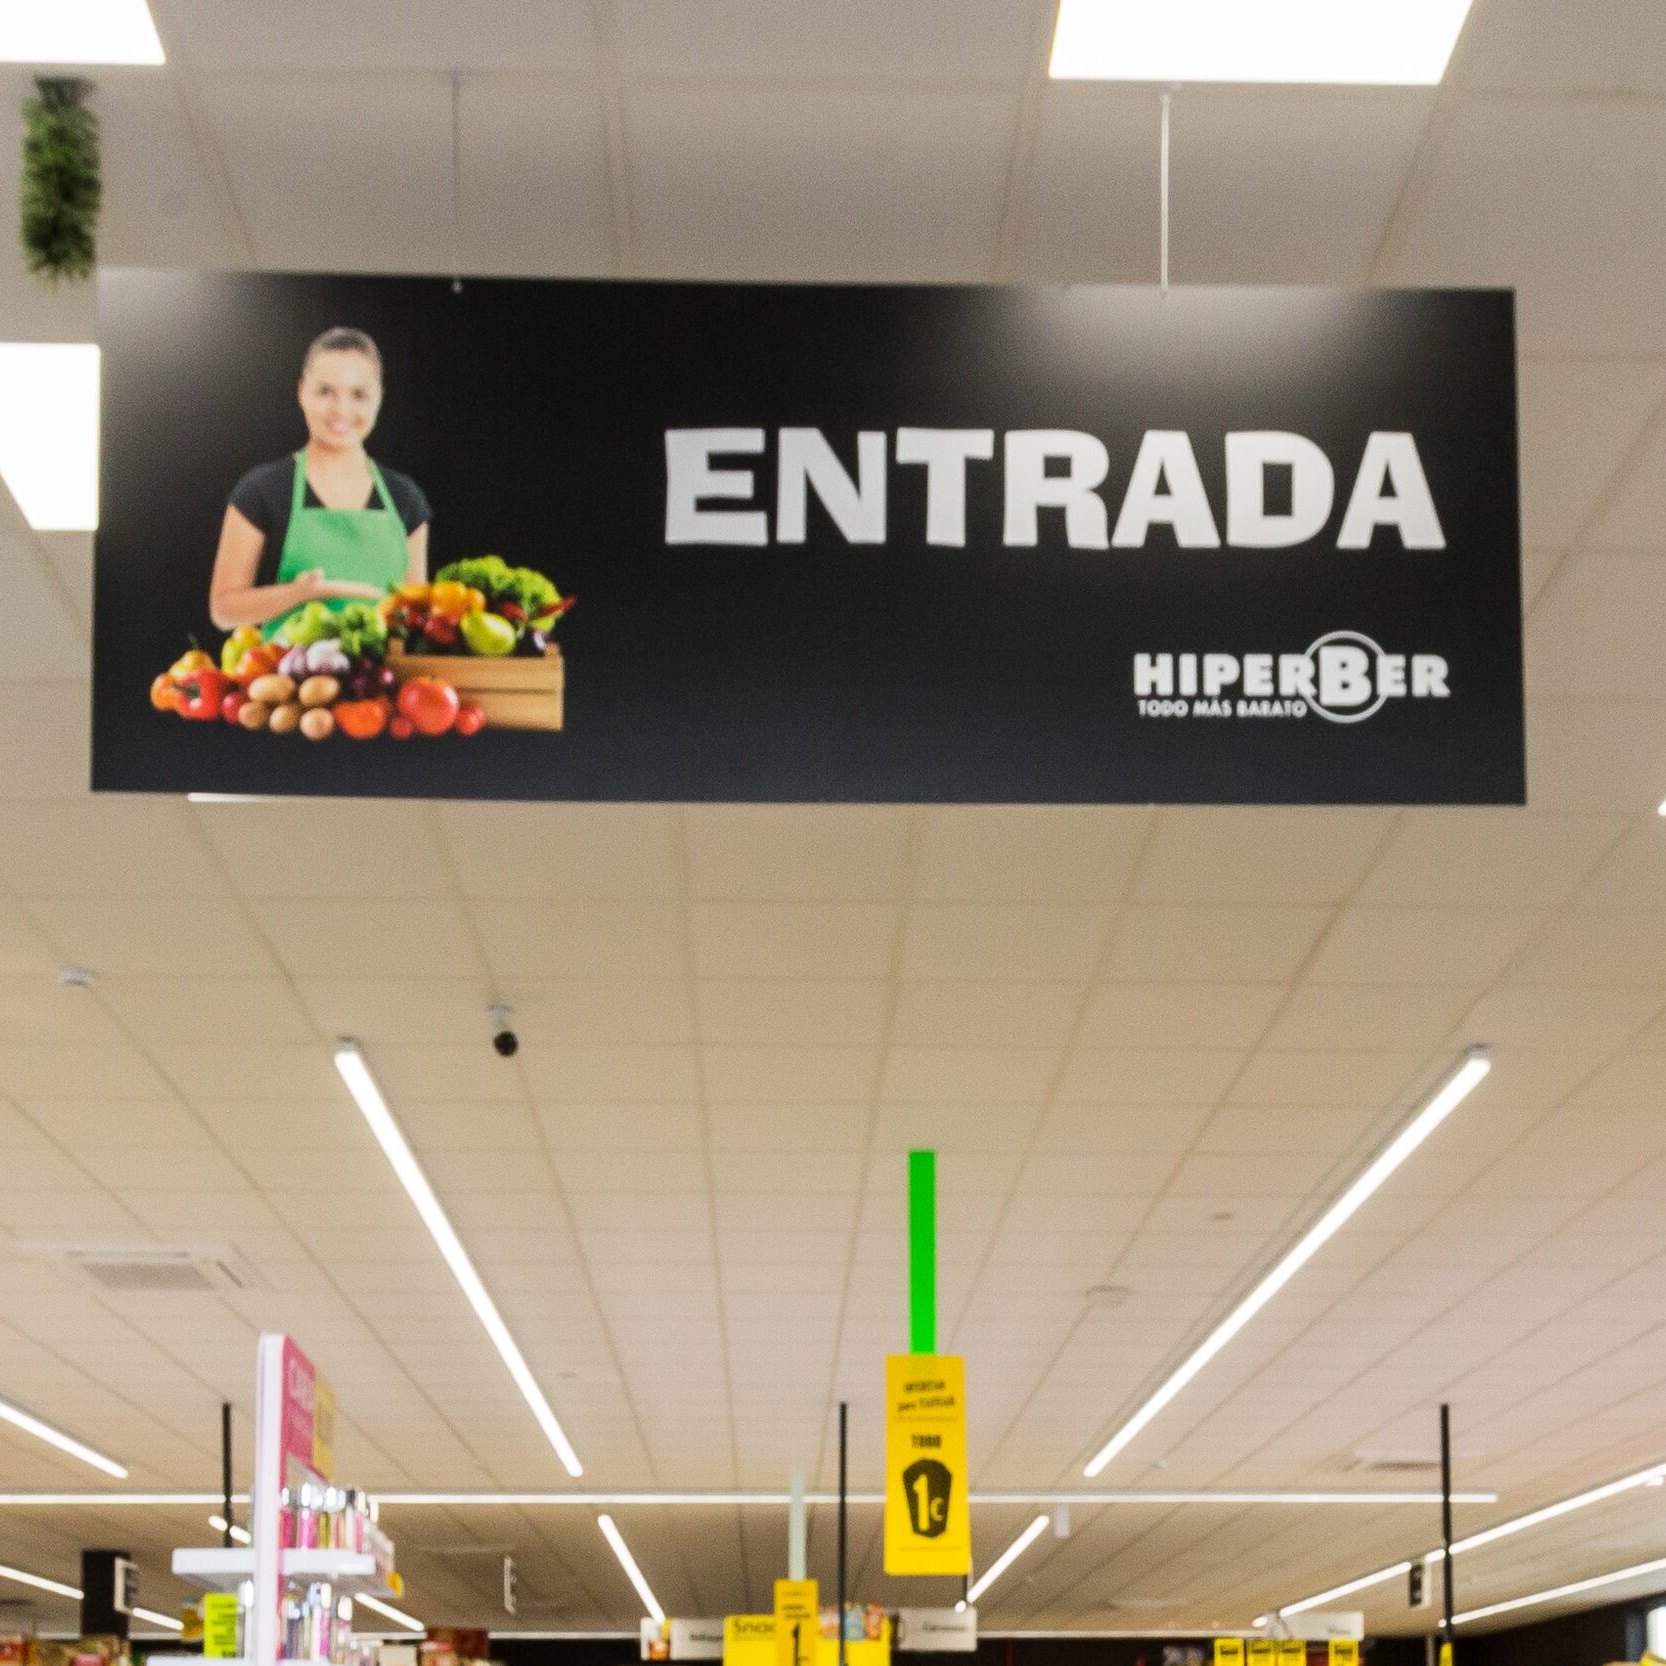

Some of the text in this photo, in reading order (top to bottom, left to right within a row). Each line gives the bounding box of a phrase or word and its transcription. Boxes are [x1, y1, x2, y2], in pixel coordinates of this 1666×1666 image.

[664, 427, 1447, 551] ENTRADA
[1133, 645, 1451, 707] HIPERBER
[1137, 699, 1189, 718] TODO
[1236, 699, 1308, 718] BARATO
